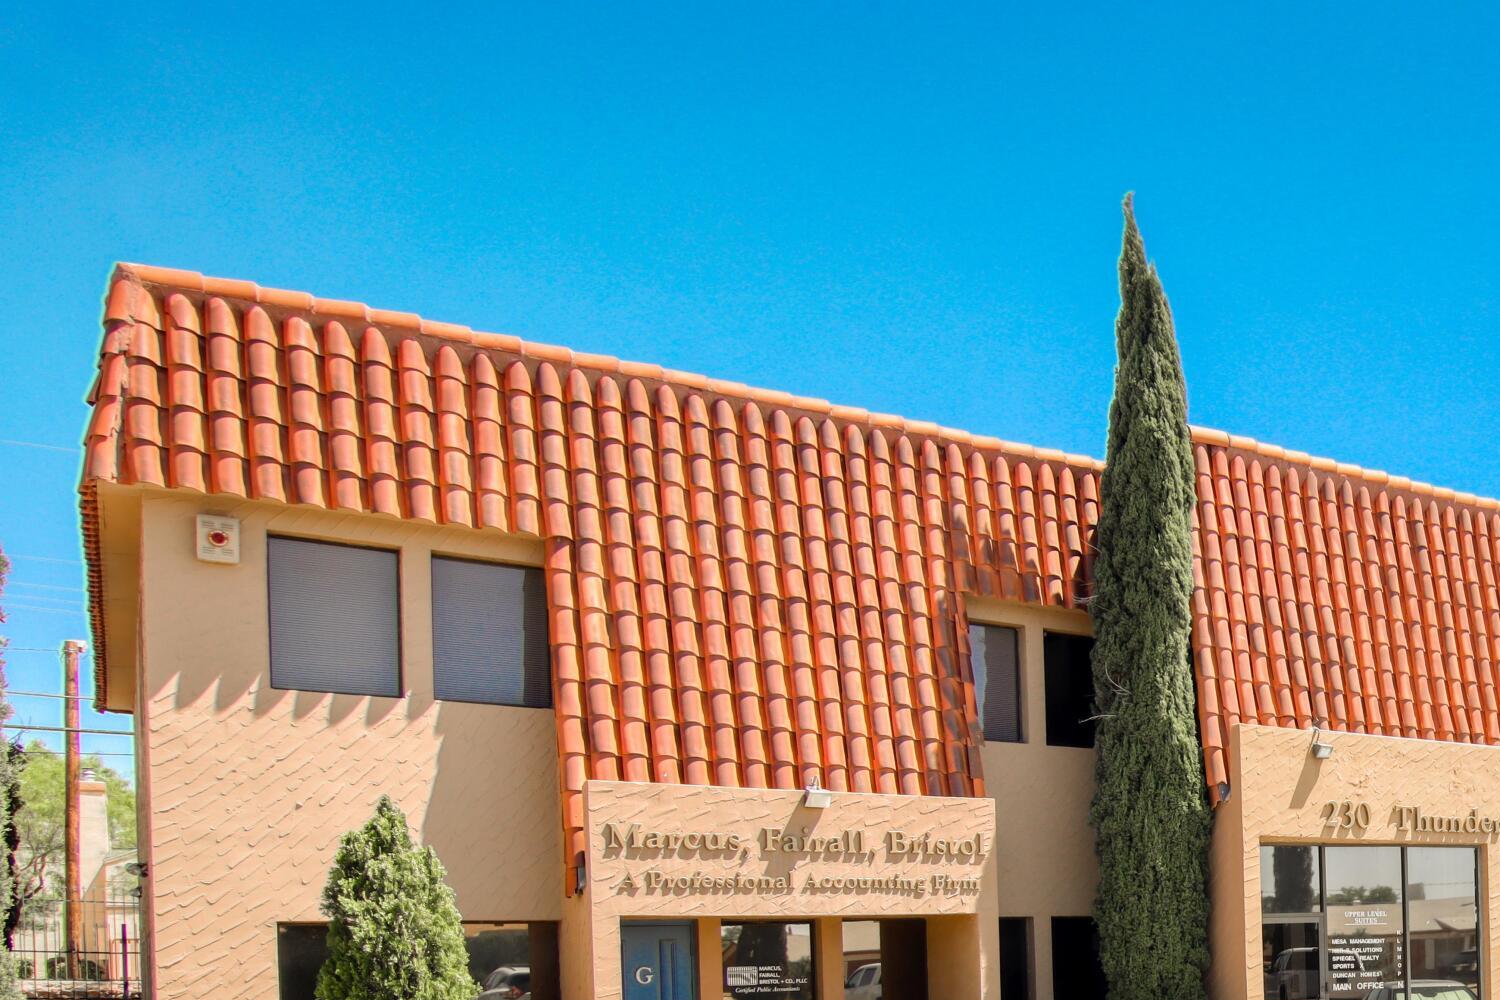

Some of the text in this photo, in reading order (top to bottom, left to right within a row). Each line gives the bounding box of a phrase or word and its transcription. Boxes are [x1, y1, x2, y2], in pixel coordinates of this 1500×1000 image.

[1325, 800, 1372, 829] 230
[606, 822, 986, 863] Marcus, Fairall, Bristol
[619, 870, 980, 894] A Professional Accounting Firm
[635, 966, 654, 985] G
[1332, 981, 1405, 991] MAIN OFFICE N
